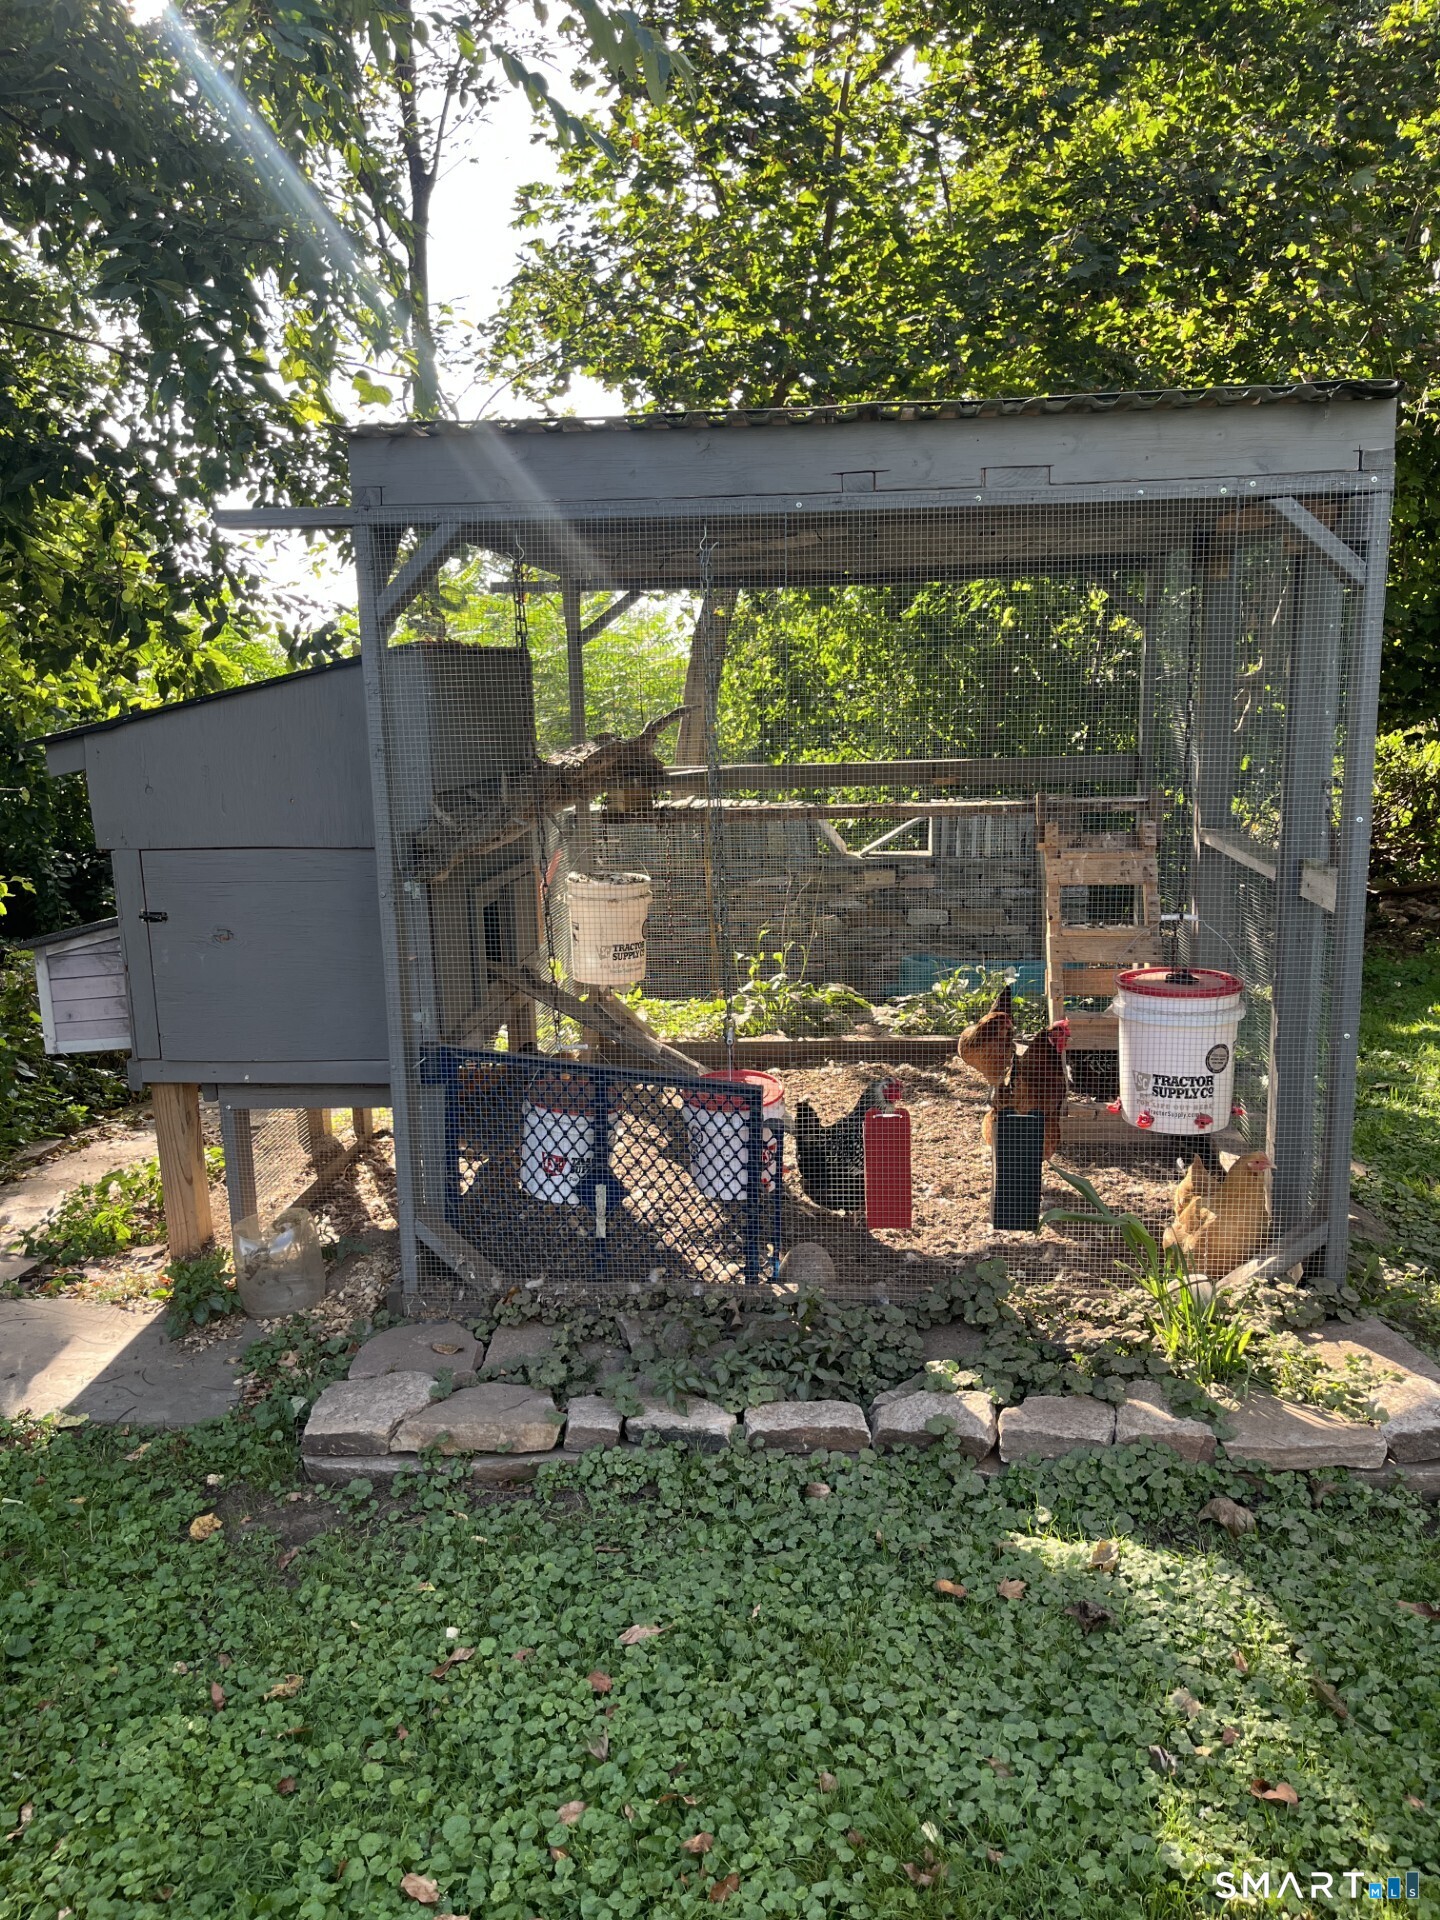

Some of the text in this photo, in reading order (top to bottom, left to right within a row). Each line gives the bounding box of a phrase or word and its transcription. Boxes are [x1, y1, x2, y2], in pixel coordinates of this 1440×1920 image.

[612, 949, 640, 961] SUPPLY
[1133, 1070, 1150, 1091] TSC
[1152, 1074, 1215, 1088] TRACTOR
[1152, 1086, 1200, 1100] SUPPLY
